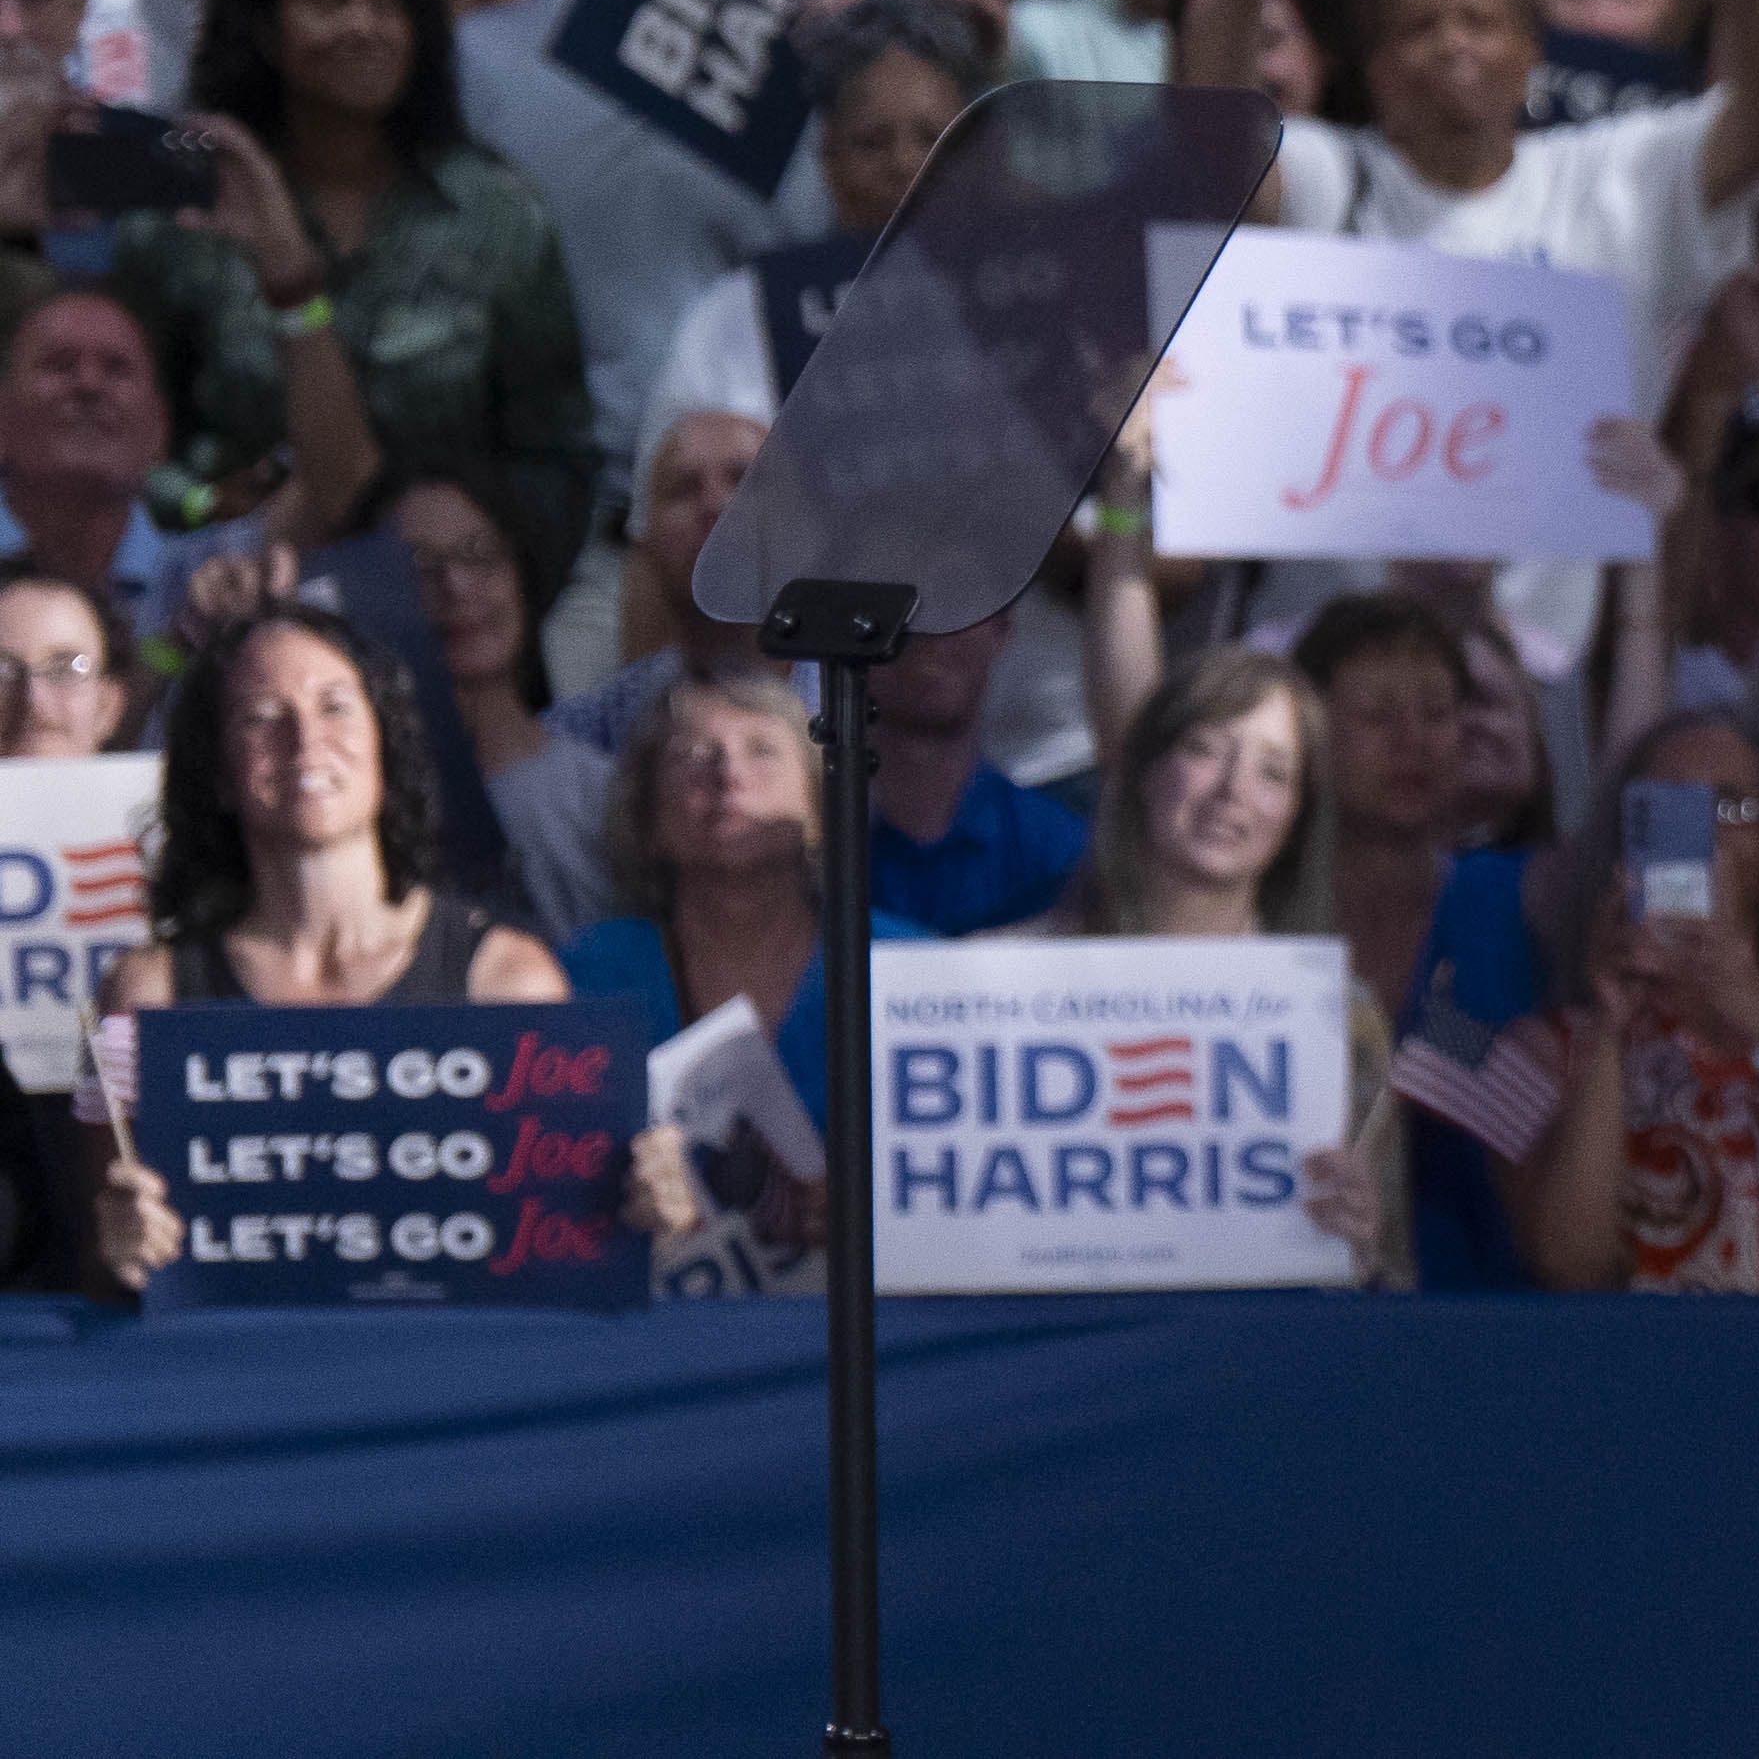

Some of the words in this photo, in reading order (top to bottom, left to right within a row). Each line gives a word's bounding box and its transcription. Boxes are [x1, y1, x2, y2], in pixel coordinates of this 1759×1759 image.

[1240, 302, 1430, 363] LET'S
[1450, 316, 1548, 364] GO
[1280, 361, 1510, 510] Joe
[1031, 991, 1232, 1023] CAROLINA
[185, 1049, 381, 1103] LET'S
[386, 1047, 492, 1101] GO
[485, 1031, 611, 1114] Joe
[891, 1034, 1292, 1130] BIDEN
[188, 1132, 381, 1184] LET'S
[387, 1131, 494, 1181] GO
[486, 1115, 611, 1195] Joe
[891, 1136, 1297, 1213] HARRIS
[189, 1213, 382, 1263] LET'S
[389, 1211, 496, 1262] GO
[489, 1195, 607, 1276] Joe
